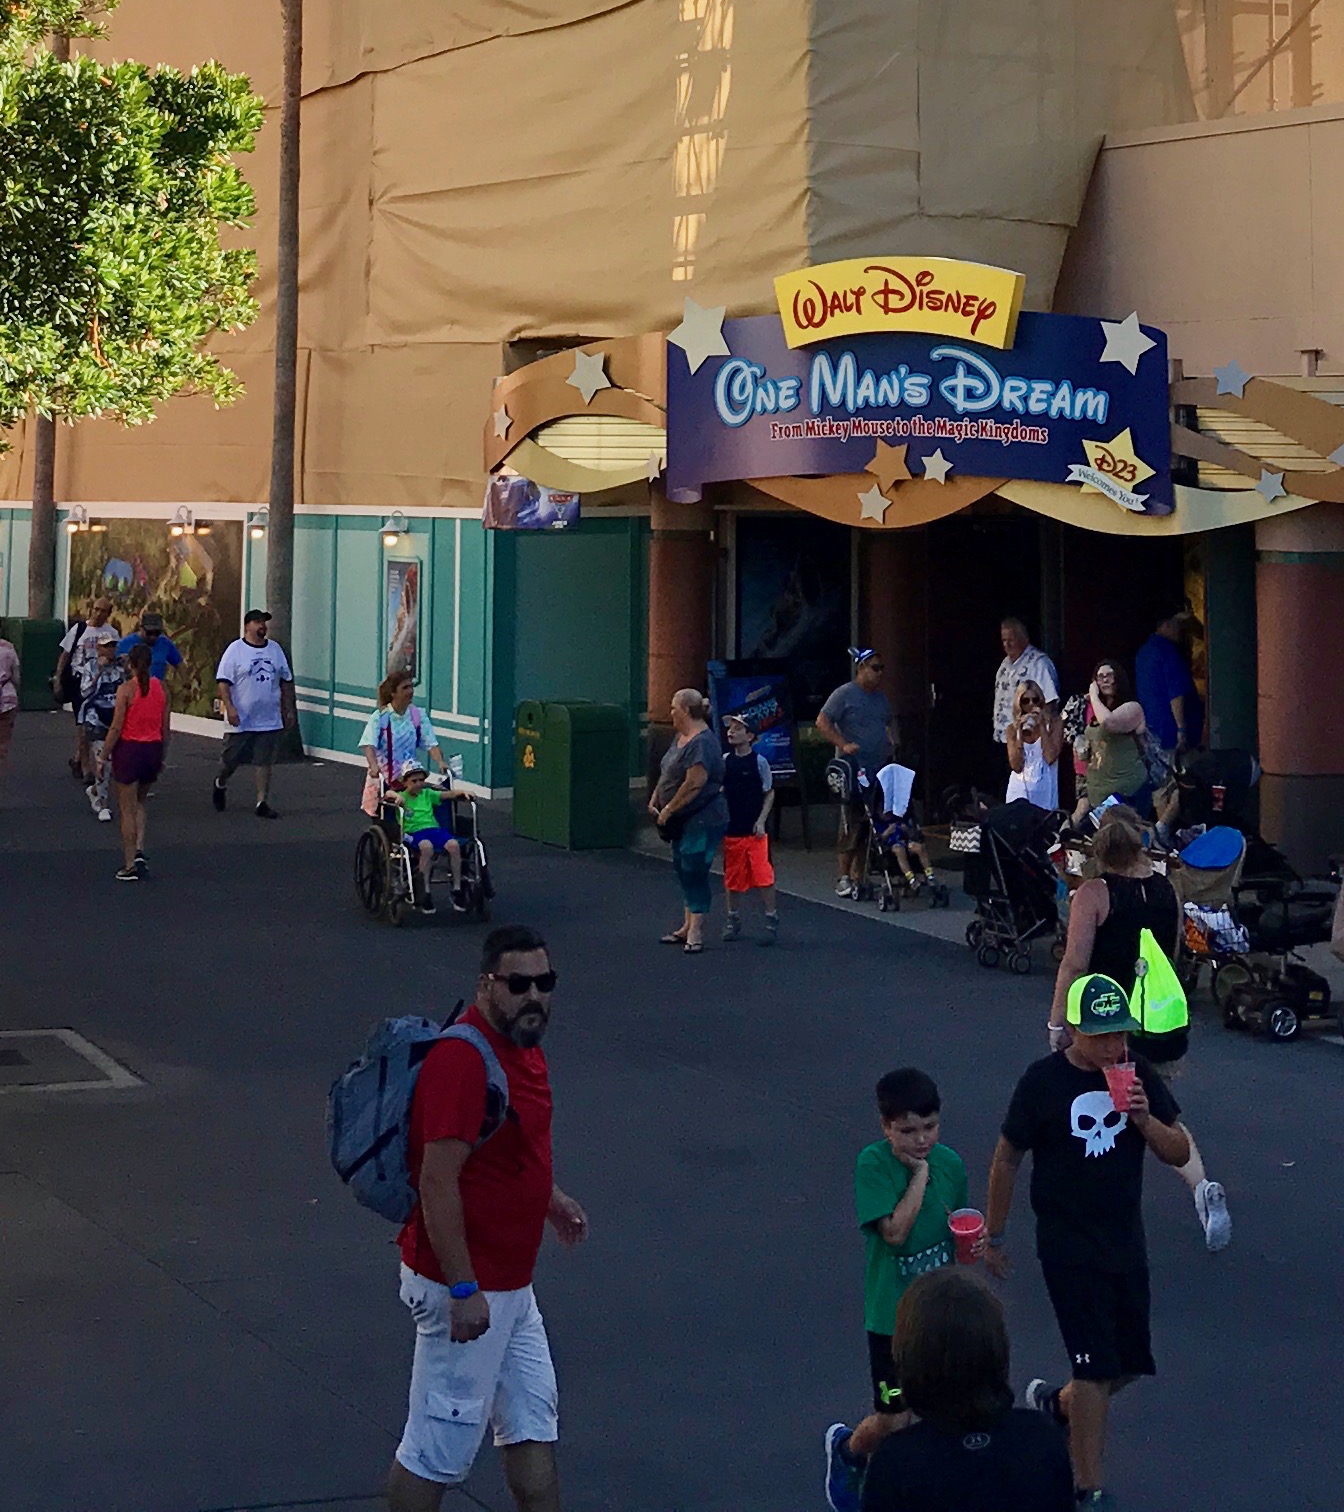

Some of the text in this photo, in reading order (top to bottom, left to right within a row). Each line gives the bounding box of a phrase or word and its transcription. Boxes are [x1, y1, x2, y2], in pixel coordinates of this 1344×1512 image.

[792, 265, 997, 336] WALT DISNEY
[809, 350, 932, 414] MAN'S
[929, 344, 1110, 425] DREAM
[770, 414, 1049, 446] From Mickey Mouse to the Magic Kingdoms
[1094, 444, 1138, 483] D23
[1077, 468, 1140, 506] Welcomes You!
